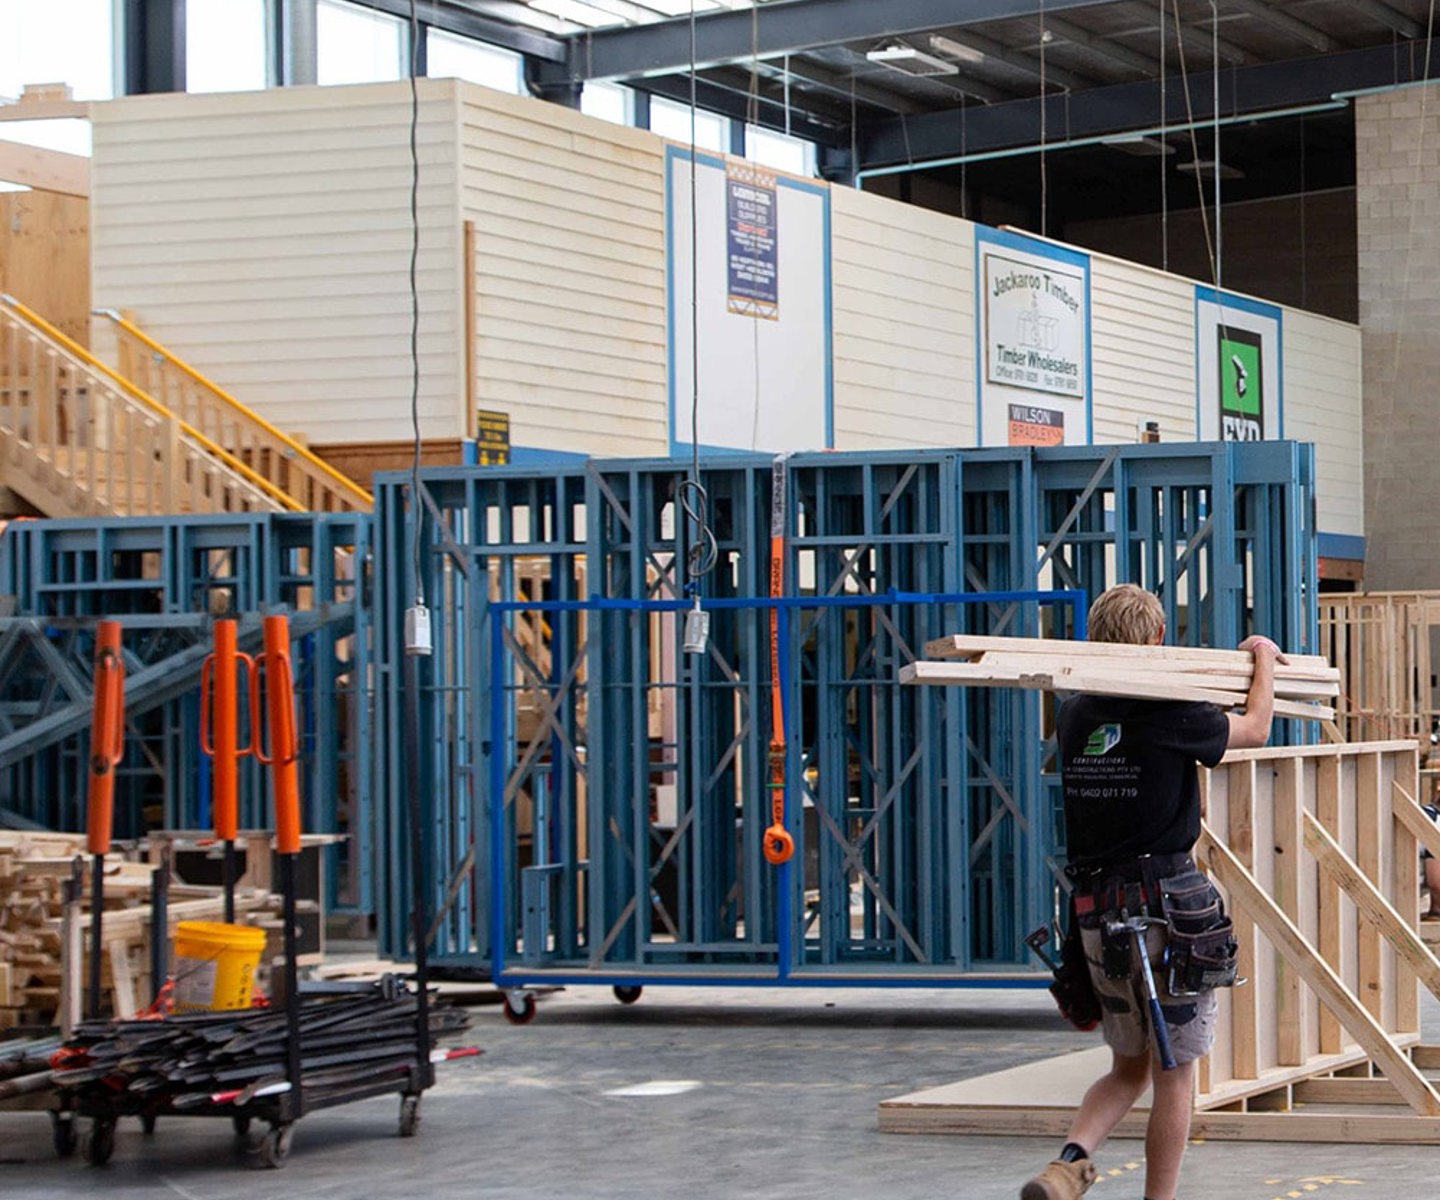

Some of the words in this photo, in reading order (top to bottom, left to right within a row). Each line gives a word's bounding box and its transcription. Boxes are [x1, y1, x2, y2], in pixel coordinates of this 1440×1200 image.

[994, 270, 1040, 296] Jackaroo
[1043, 275, 1078, 312] Timber
[997, 344, 1026, 366] Timber
[1028, 350, 1078, 376] Wholesalers
[1012, 406, 1050, 424] WILSON
[1102, 788, 1118, 797] 071
[1121, 788, 1138, 797] 719
